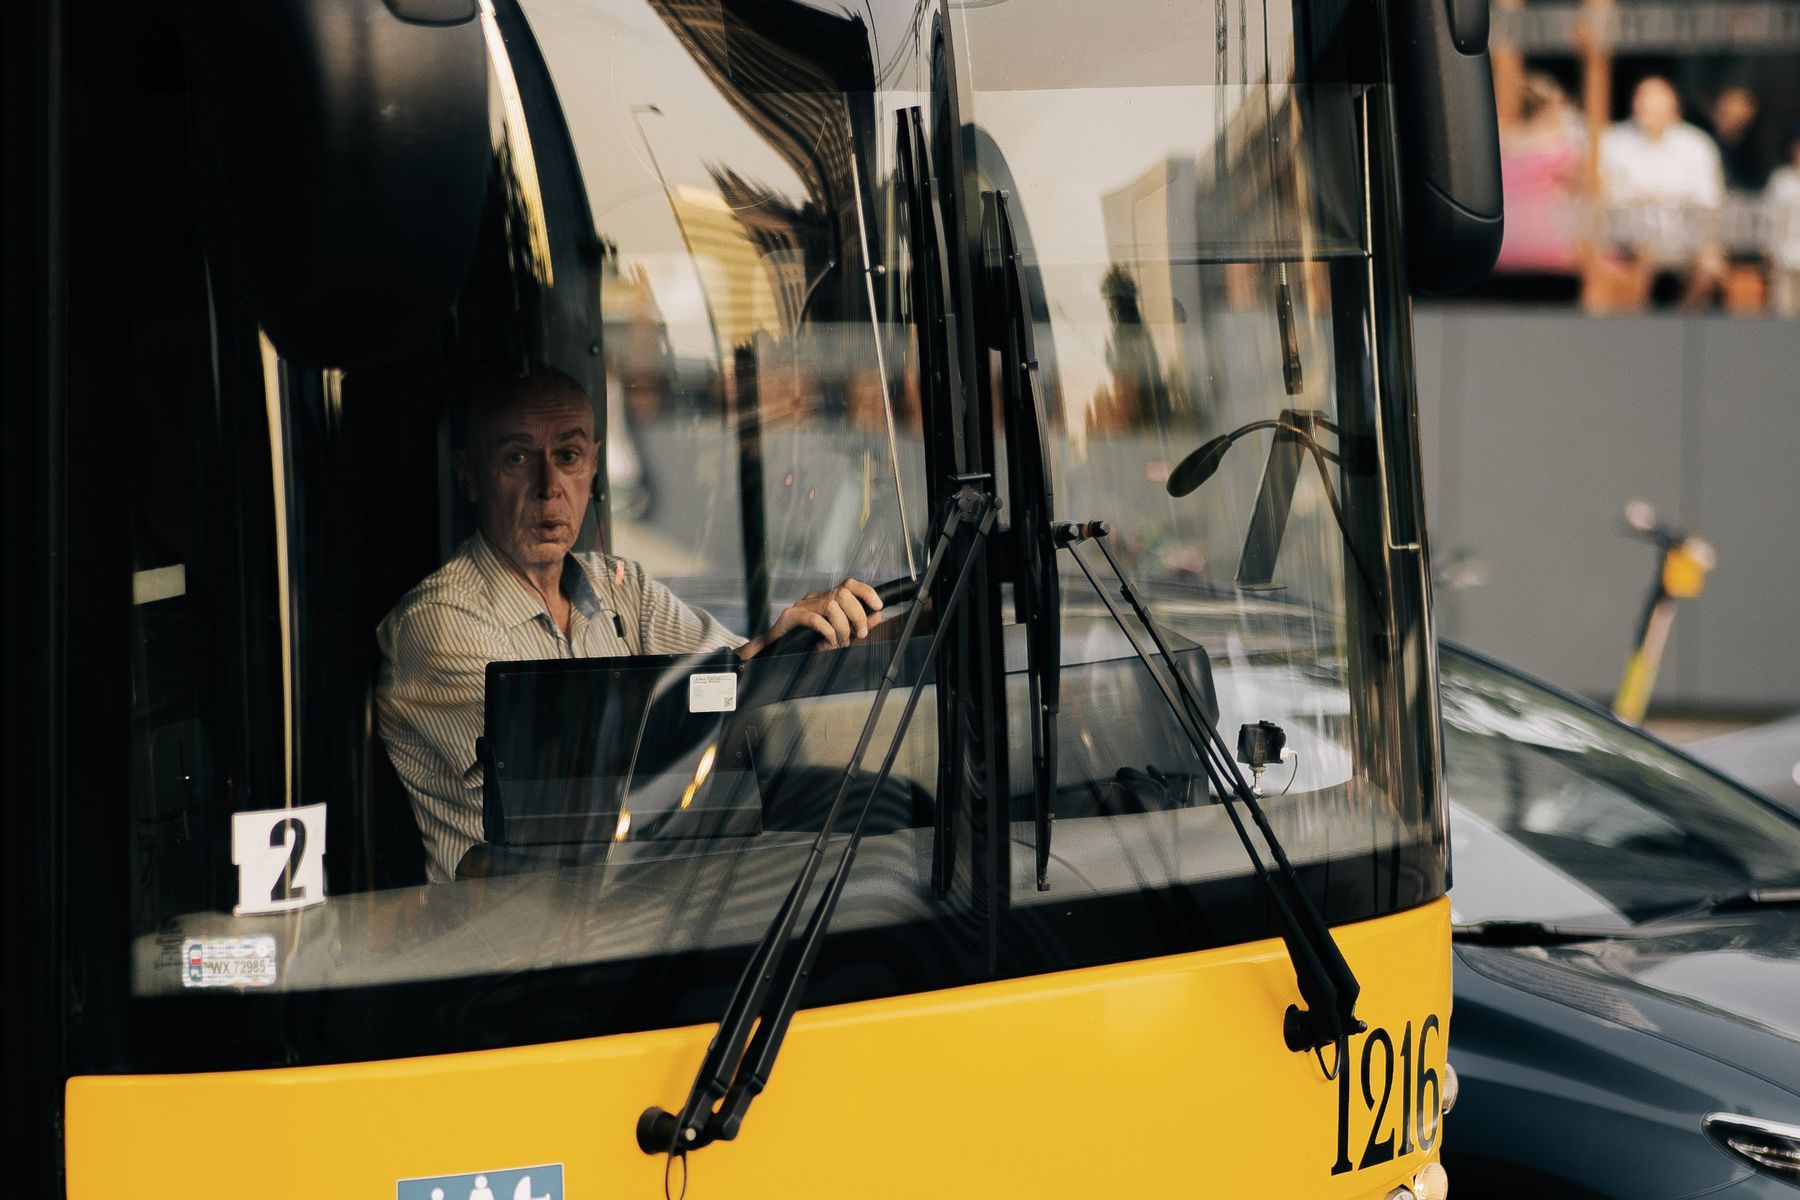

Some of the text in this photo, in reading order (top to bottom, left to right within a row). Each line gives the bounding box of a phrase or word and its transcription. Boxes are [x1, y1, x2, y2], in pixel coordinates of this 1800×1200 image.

[269, 817, 306, 902] 2
[210, 959, 266, 975] WX 72985
[1330, 1013, 1440, 1177] 1216
